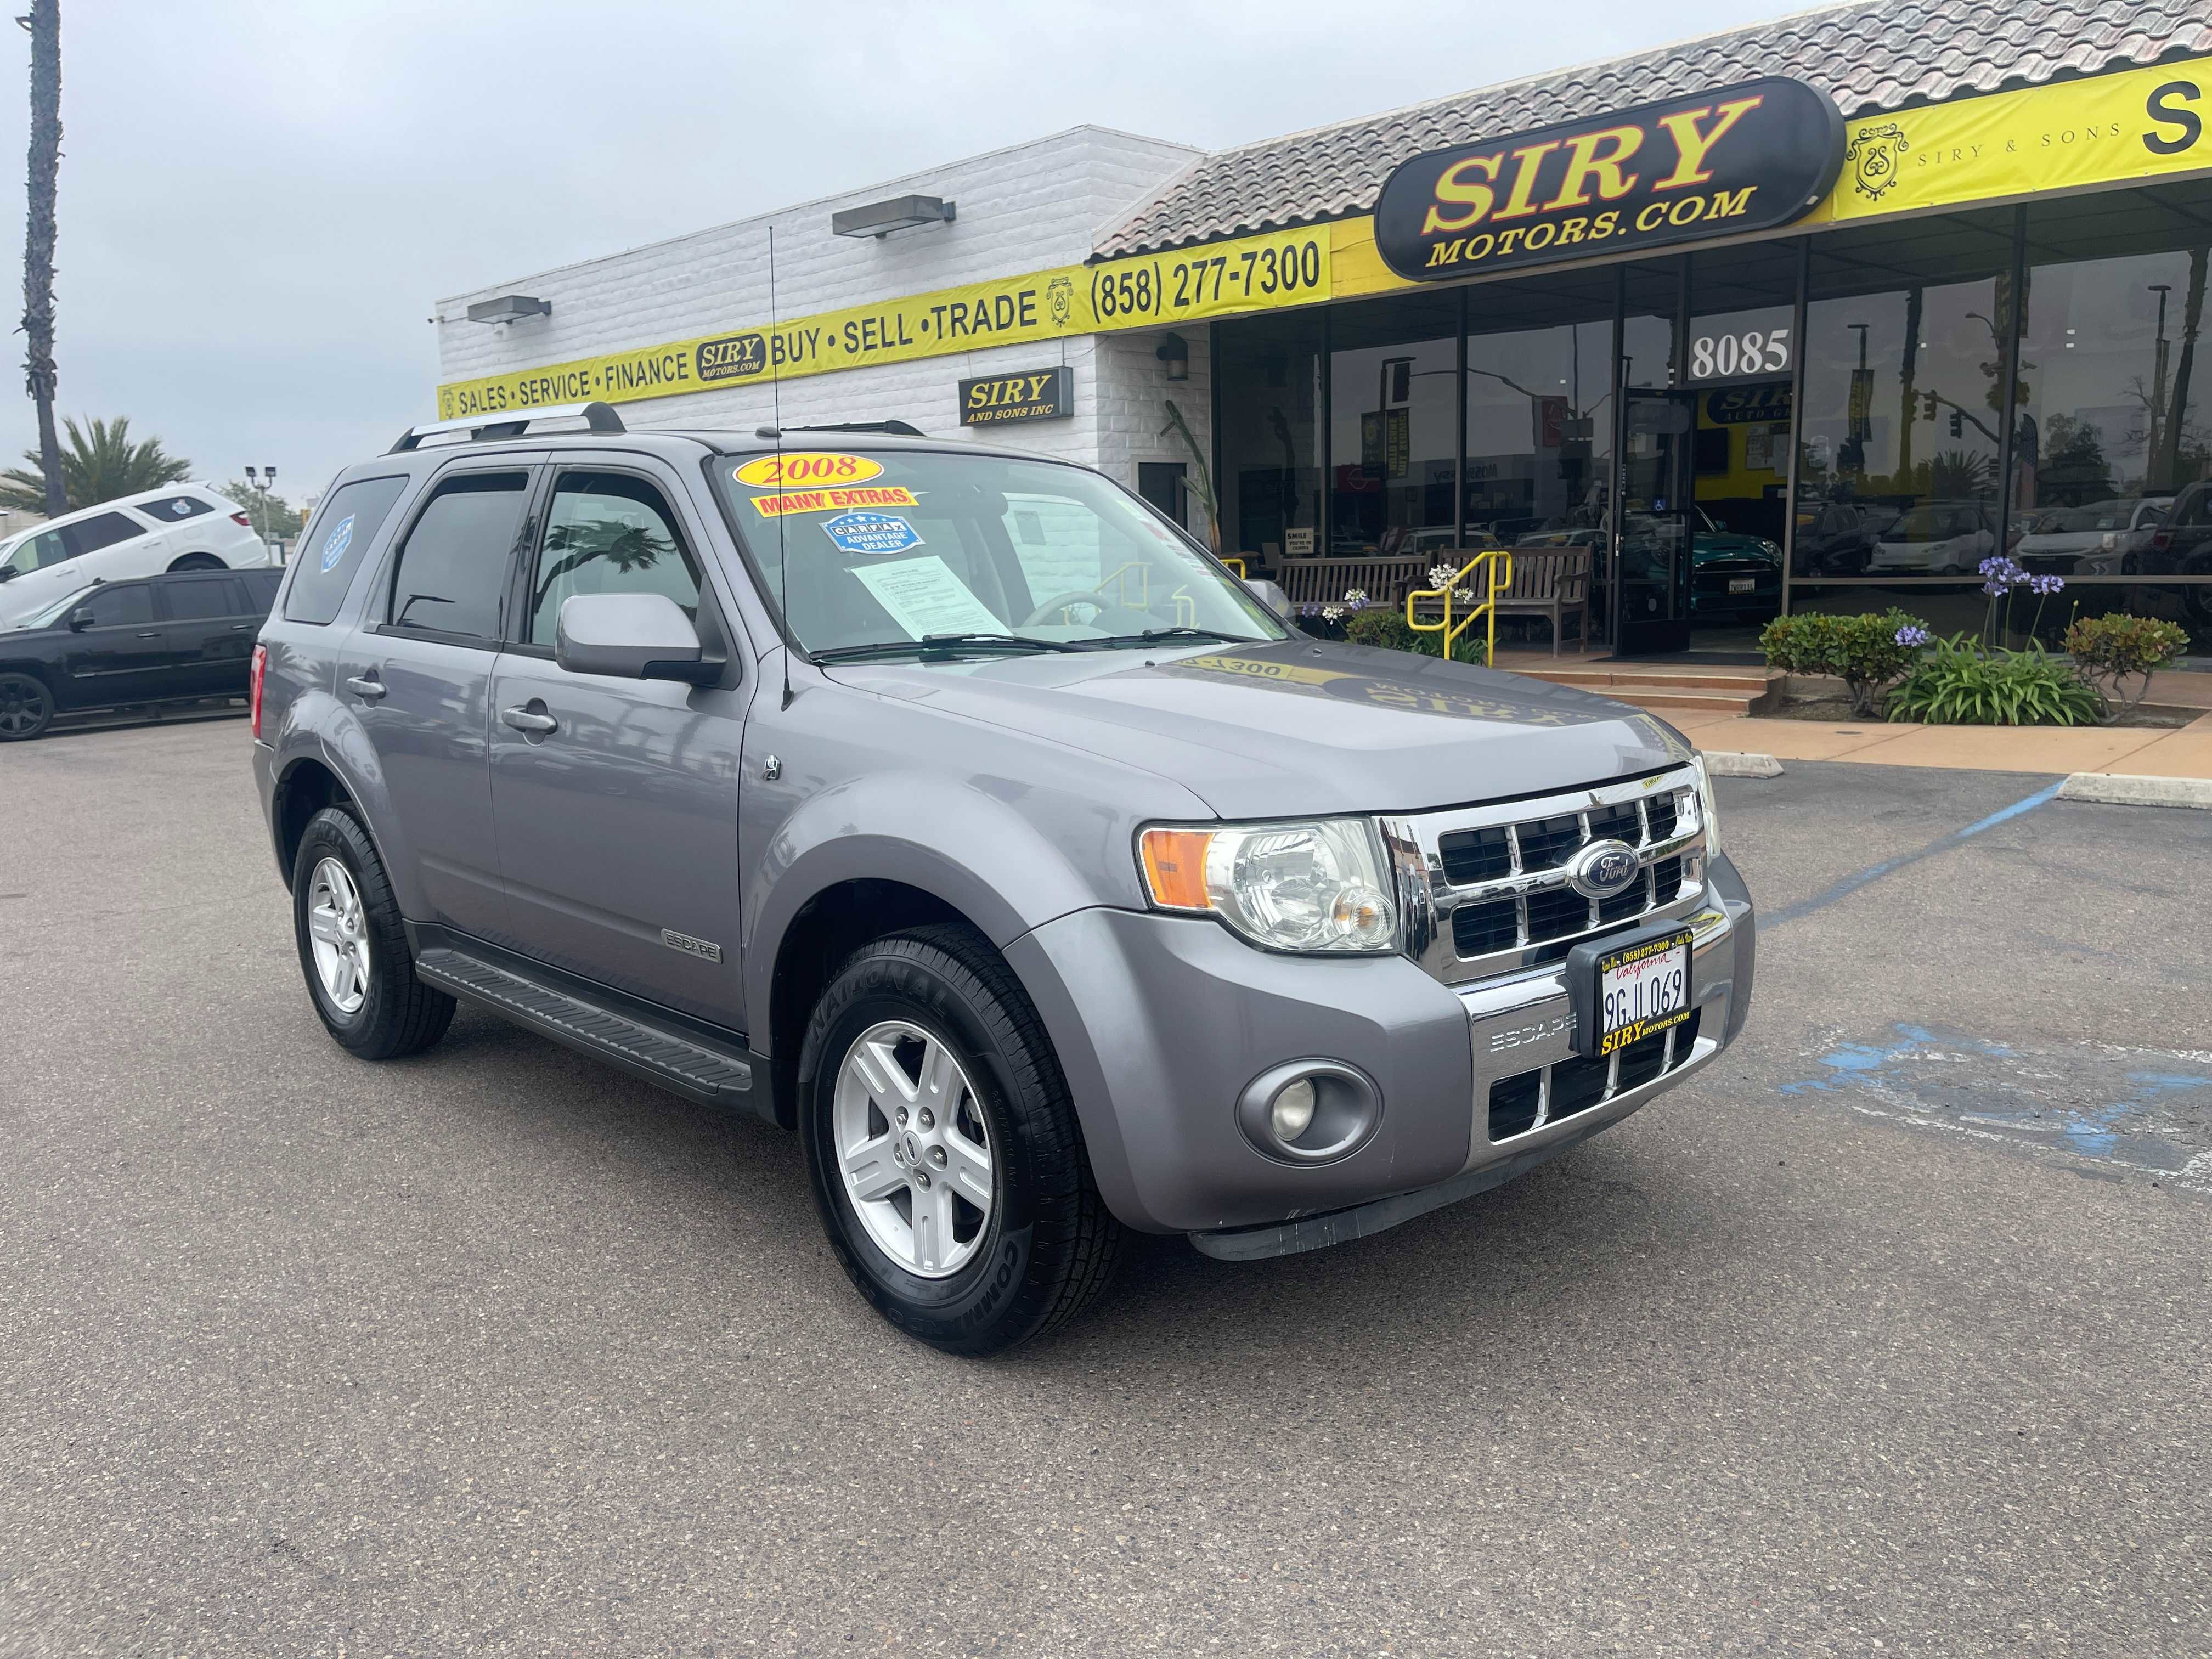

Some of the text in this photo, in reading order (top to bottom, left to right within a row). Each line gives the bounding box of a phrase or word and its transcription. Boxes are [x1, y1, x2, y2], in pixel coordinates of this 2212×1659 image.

[1918, 123, 2120, 166] SIRY & SONS
[1420, 94, 1764, 236] SIRY
[1425, 186, 1758, 268] MOTORS.COM
[1091, 241, 1319, 323] (858) 277-7300
[771, 290, 1037, 365] BUY SELL TRADE
[701, 337, 760, 368] SIRY
[1692, 329, 1788, 377] 8085
[459, 352, 689, 414] SALES SERVICE FINANCE
[702, 360, 761, 378] MOTORS.COM
[968, 375, 1052, 409] SIRY
[967, 404, 1054, 423] AND SONS INC
[761, 457, 856, 484] 2008
[759, 489, 911, 515] MANY EXTRAS
[833, 522, 905, 535] CARFAX
[847, 532, 908, 544] ADVANTAGE
[862, 540, 904, 550] DEALER
[1599, 855, 1629, 882] Ford
[665, 933, 716, 958] ESCAPE
[1623, 940, 1669, 964] (858) 277-7300
[1616, 952, 1672, 980] California
[808, 964, 949, 1043] NATIONAL
[1605, 969, 1681, 1032] 9GJL069
[1489, 1013, 1577, 1052] ESCAPE
[1601, 1011, 1690, 1056] SIRY MOTORS.COM
